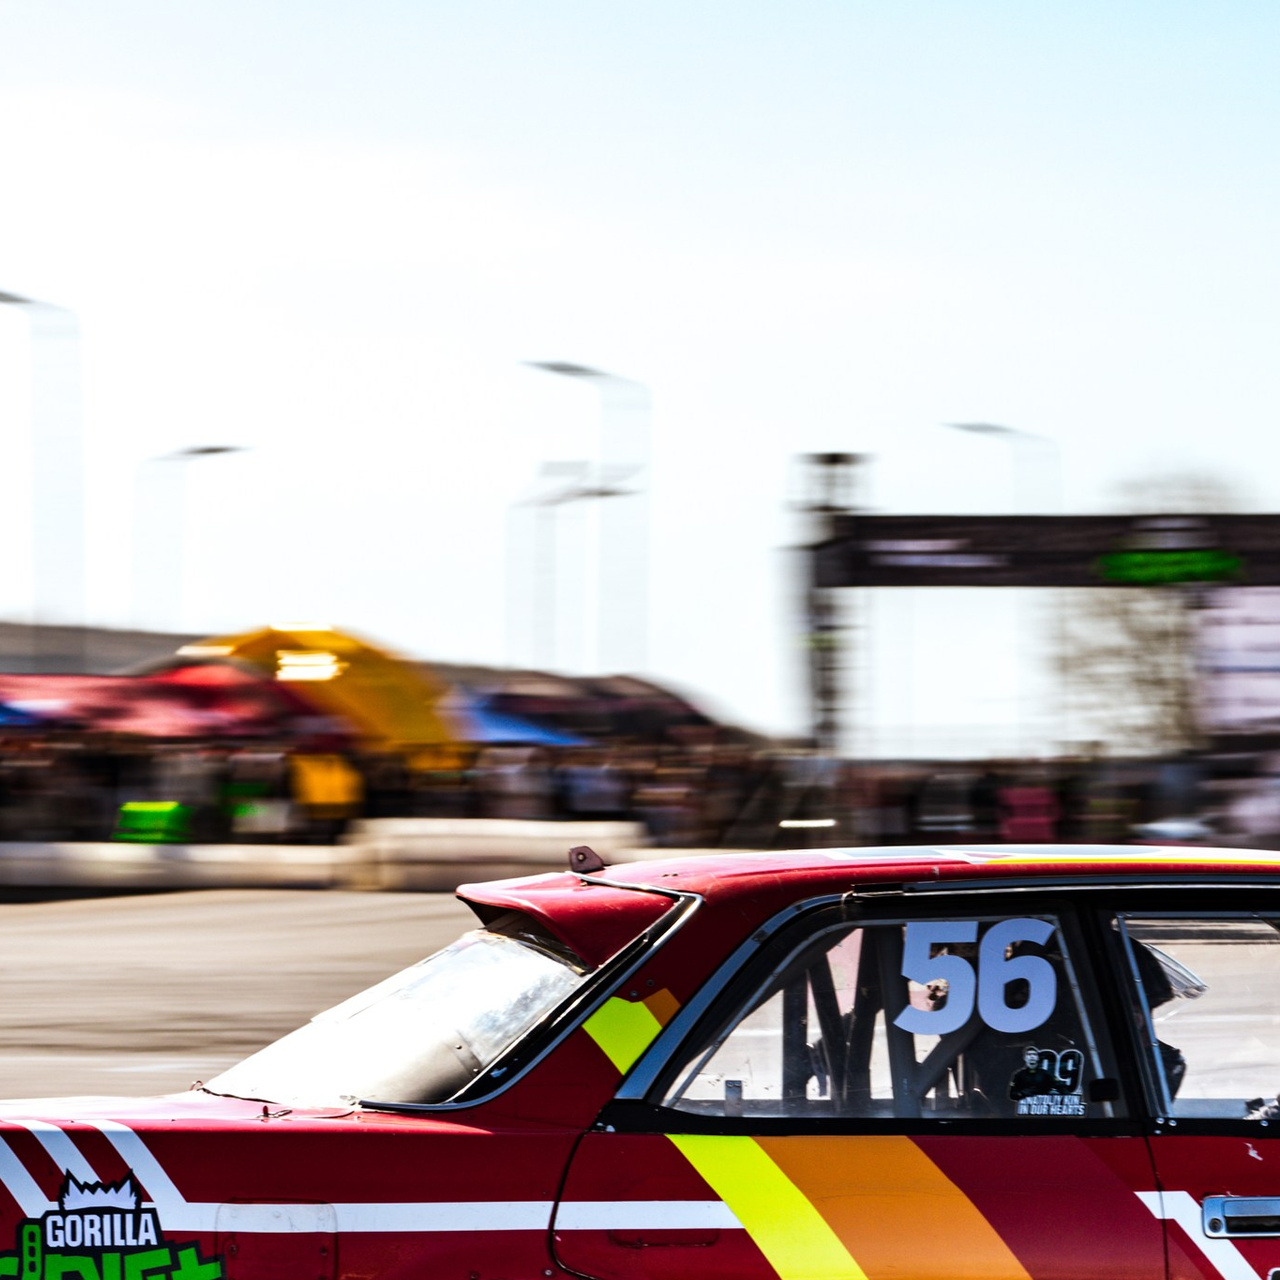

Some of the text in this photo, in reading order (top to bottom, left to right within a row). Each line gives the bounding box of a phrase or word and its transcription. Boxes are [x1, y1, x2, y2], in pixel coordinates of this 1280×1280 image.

[893, 918, 1057, 1035] 56
[1017, 1104, 1086, 1116] IN OUR HEARTS
[45, 1213, 158, 1247] GORILLA
